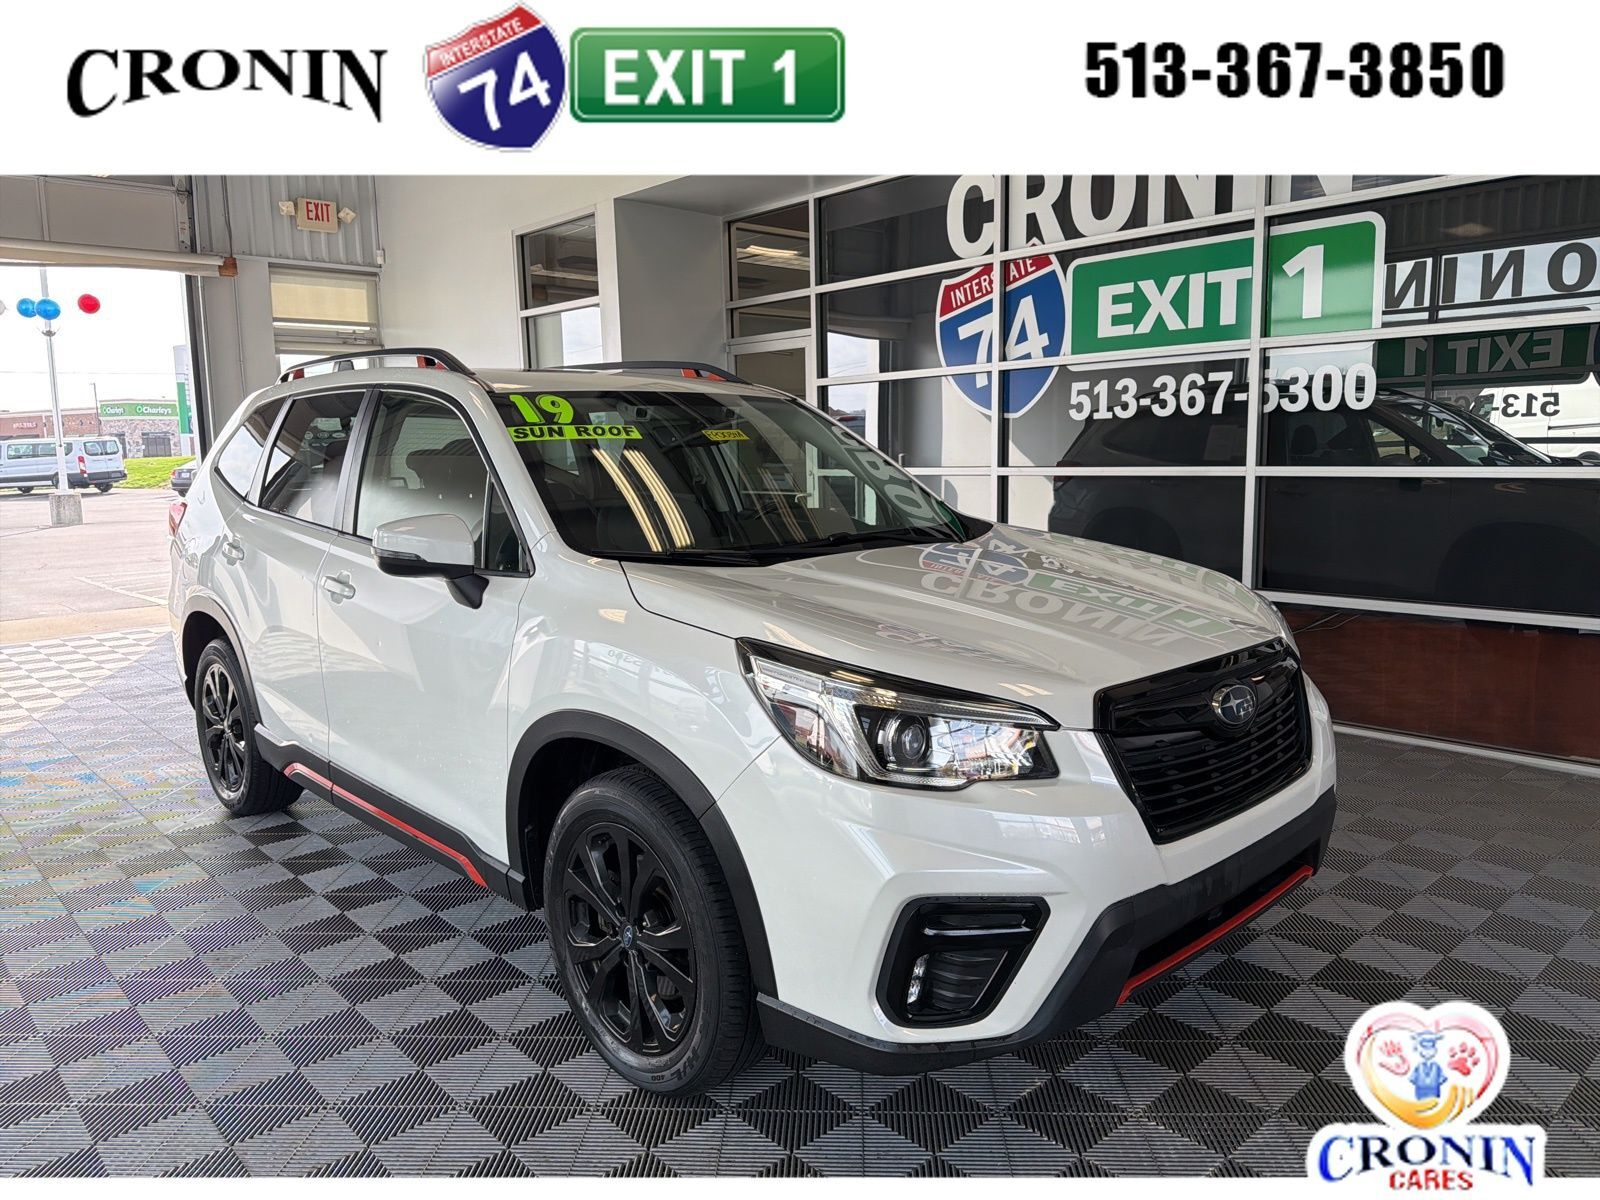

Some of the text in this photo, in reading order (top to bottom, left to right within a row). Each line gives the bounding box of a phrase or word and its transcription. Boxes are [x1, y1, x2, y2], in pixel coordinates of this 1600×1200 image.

[306, 201, 331, 222] EXIT
[1097, 245, 1325, 338] EXIT 1
[957, 295, 1050, 389] 74
[510, 394, 574, 424] 19
[513, 425, 635, 439] SUN ROOF
